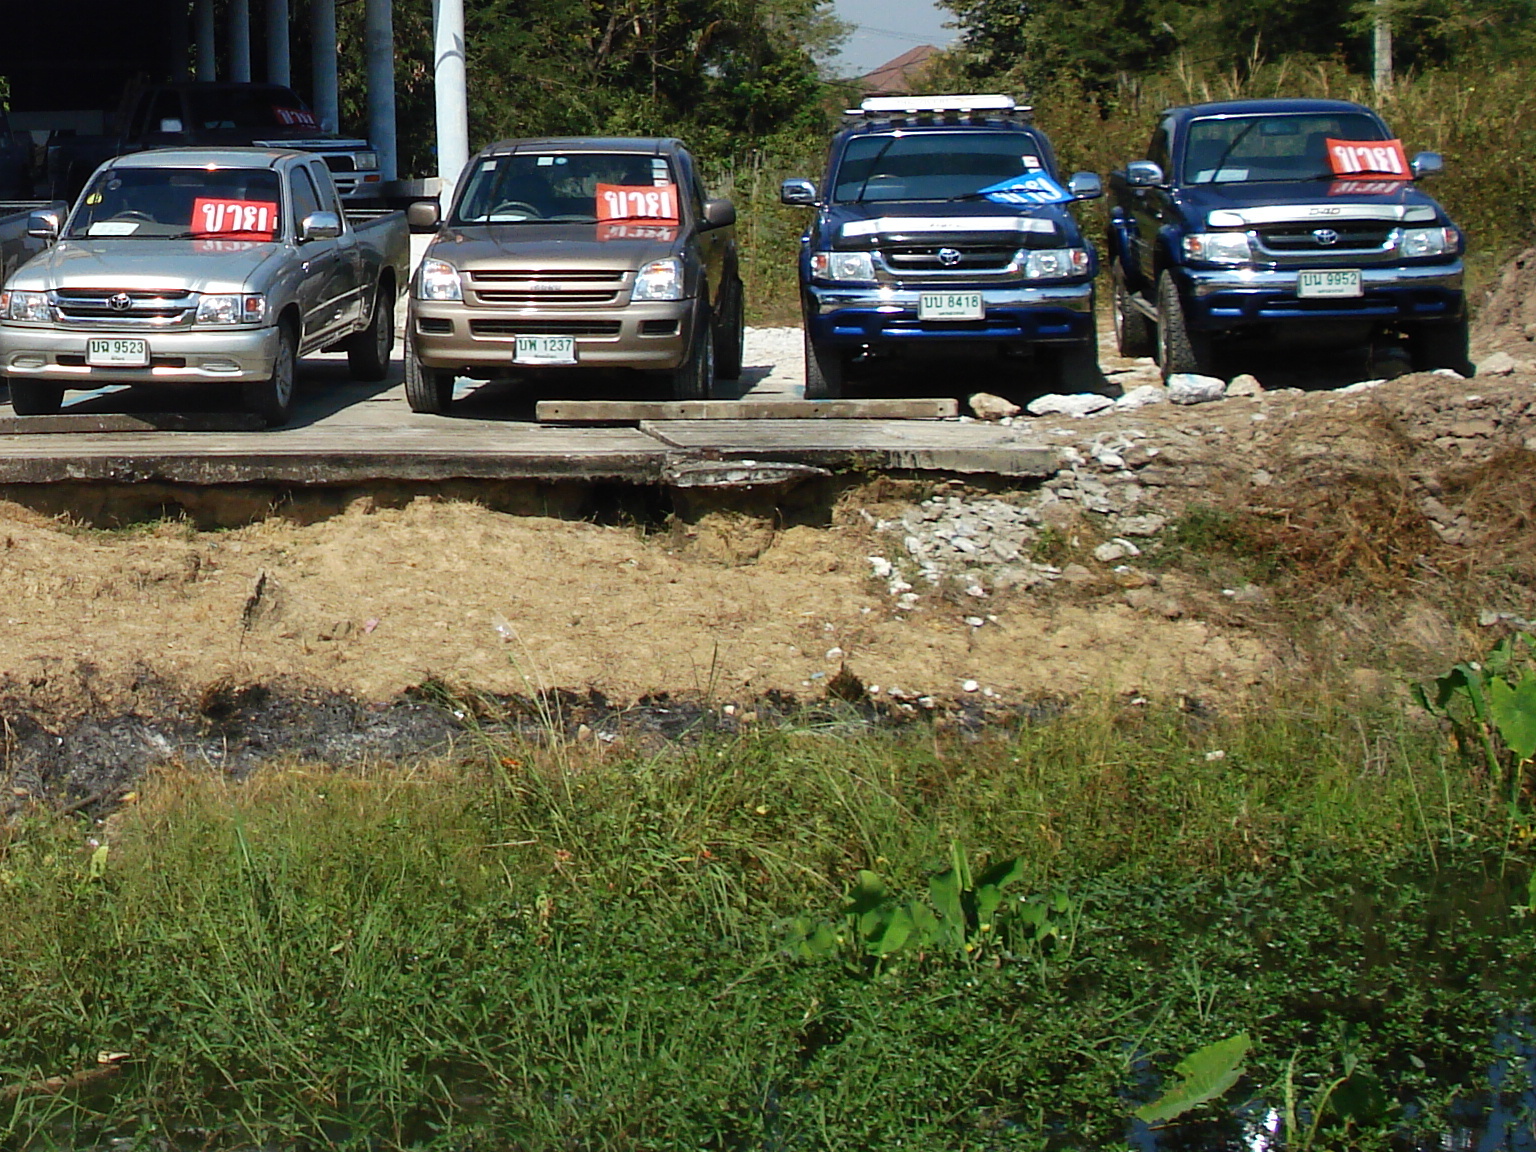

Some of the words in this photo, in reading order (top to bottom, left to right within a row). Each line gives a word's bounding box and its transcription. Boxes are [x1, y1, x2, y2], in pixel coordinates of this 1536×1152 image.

[1333, 144, 1402, 175] ขาย
[605, 191, 671, 221] ขาย
[202, 203, 267, 233] ขาย
[1326, 272, 1357, 286] 9952
[948, 295, 979, 308] 8418
[114, 340, 144, 354] 9523
[543, 339, 572, 352] 1237
